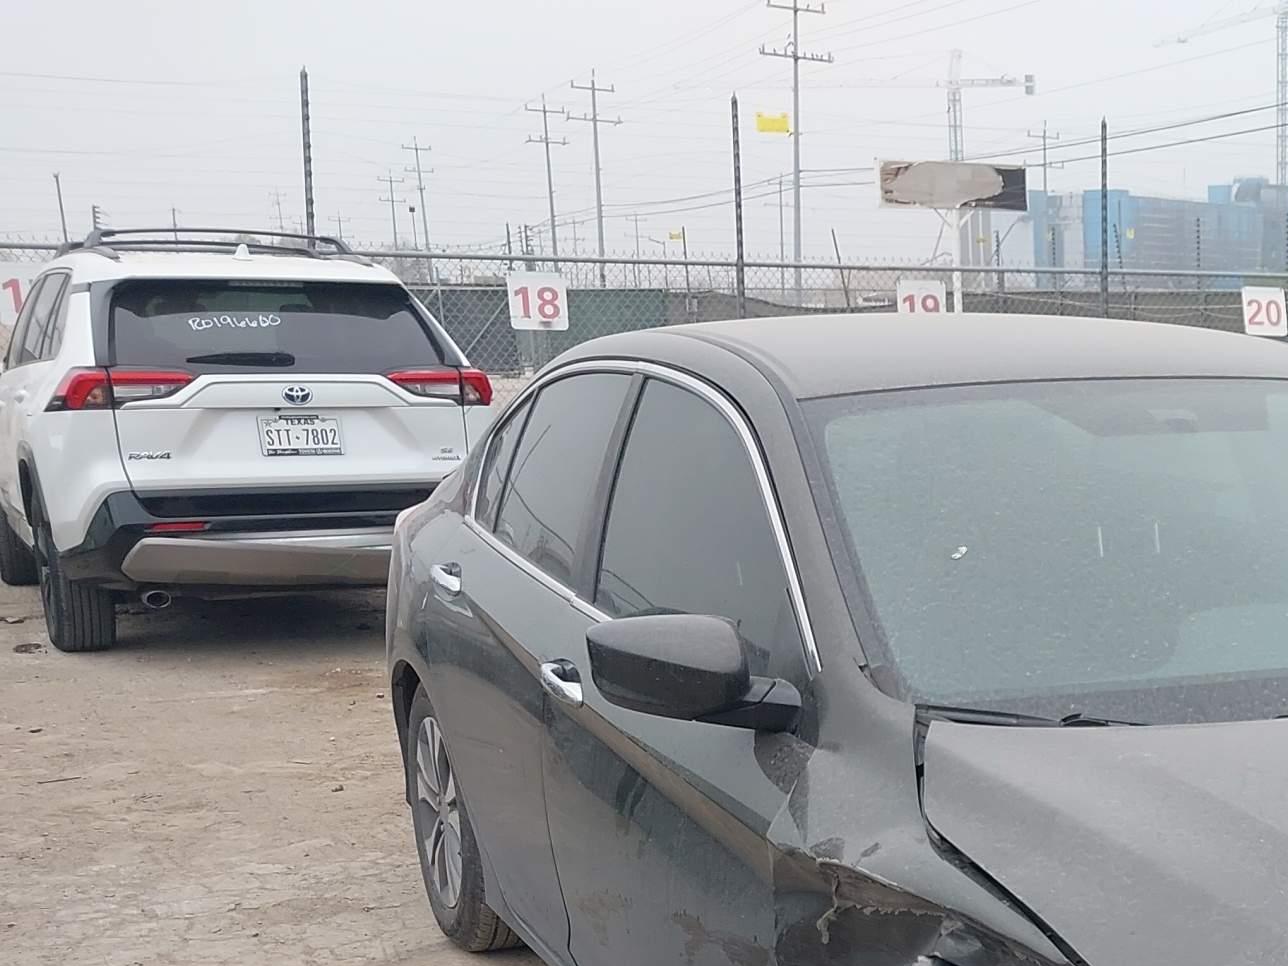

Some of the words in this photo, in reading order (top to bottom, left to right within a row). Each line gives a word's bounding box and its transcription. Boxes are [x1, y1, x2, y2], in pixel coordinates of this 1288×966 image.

[514, 286, 560, 319] 18
[903, 294, 940, 313] 19
[1247, 299, 1282, 326] 20
[128, 451, 172, 460] RAV4
